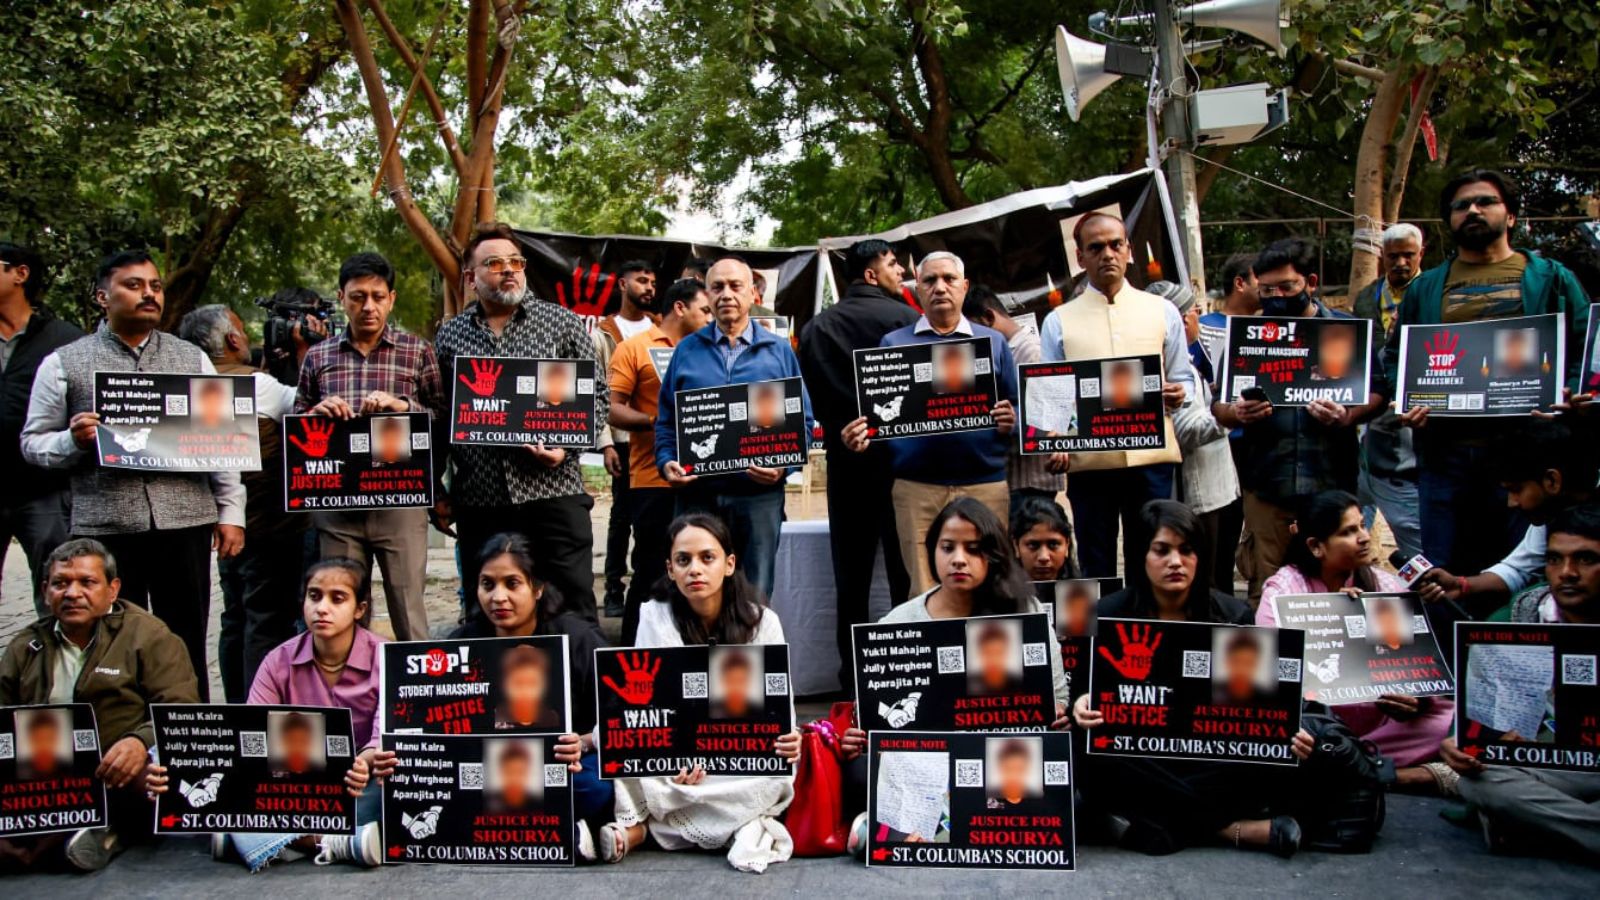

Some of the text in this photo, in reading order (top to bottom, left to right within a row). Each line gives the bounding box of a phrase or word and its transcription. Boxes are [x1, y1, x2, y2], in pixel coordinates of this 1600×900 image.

[1247, 322, 1296, 342] STOP!
[1239, 347, 1309, 356] STUDENT HARASSMENT
[1259, 359, 1304, 373] JUSTICE
[1429, 354, 1455, 366] STOP
[1271, 371, 1293, 382] FOR
[1417, 377, 1464, 385] HARASSMENT
[126, 391, 161, 400] Mahajan
[928, 394, 988, 406] JUSTICE FOR
[1285, 388, 1353, 401] SHOURYA
[473, 399, 511, 412] WANT
[927, 405, 989, 418] SHOURYA
[105, 416, 143, 425] Aparajita
[458, 412, 508, 425] JUSTICE
[1092, 414, 1131, 423] JUSTICE
[524, 420, 587, 430] SHOURYA
[879, 416, 996, 436] ST. COLUMBA'S SCHOOL
[1092, 424, 1157, 435] SHOURYA
[470, 432, 591, 444] ST. COLUMBA'S SCHOOL
[740, 435, 776, 444] JUSTICE
[1039, 436, 1161, 450] ST. COLUMBA'S SCHOOL
[740, 443, 799, 455] SHOURYA
[121, 456, 257, 467] ST. COLUMBA'S SCHOOL
[305, 460, 344, 474] WANT
[695, 453, 804, 472] ST. COLUMBA'S SCHOOL
[360, 470, 400, 478] JUSTICE
[291, 474, 342, 489] JUSTICE
[360, 480, 424, 491] SHOURYA
[305, 494, 429, 507] ST. COLUMBA'S SCHOOL
[868, 632, 894, 640] Manu
[1519, 632, 1550, 641] NOTE
[863, 645, 931, 657] Yukti Mahajan
[407, 646, 470, 674] STOP!
[1368, 656, 1435, 668] JUSTICE FOR
[888, 661, 932, 673] Verghese
[1371, 669, 1441, 681] SHOURYA
[398, 683, 490, 697] STUDENT HARASSMENT
[868, 679, 912, 690] Aparajita
[1320, 680, 1453, 700] ST. COLUMBA'S SCHOOL
[1119, 685, 1174, 704] WANT
[954, 695, 1041, 709] JUSTICE FOR
[168, 712, 194, 720] Manu
[426, 698, 485, 723] JUSTICE
[1100, 705, 1169, 725] JUSTICE
[1193, 706, 1288, 720] JUSTICE FOR
[608, 709, 676, 728] WE WANT
[955, 710, 1043, 726] SHOURYA
[163, 727, 234, 737] Yukti Mahajan
[443, 719, 471, 734] FOR
[697, 724, 781, 734] JUSTICE FOR
[1193, 720, 1287, 737] SHOURYA
[605, 728, 673, 750] JUSTICE
[880, 739, 947, 749] SUICIDE NOTE
[191, 742, 235, 753] Verghese
[396, 742, 419, 752] Manu
[1114, 736, 1292, 758] ST. COLUMBA'S SCHOOL
[1486, 746, 1509, 760] ST.
[170, 758, 215, 769] Aparajita
[415, 759, 453, 769] Mahajan
[624, 759, 643, 773] ST.
[729, 757, 787, 771] SCHOOL
[2, 777, 91, 794] JUSTICE FOR
[413, 775, 453, 785] Verghese
[256, 784, 342, 794] JUSTICE FOR
[2, 791, 93, 810] SHOURYA
[393, 790, 434, 801] Aparajita
[256, 798, 343, 812] SHOURYA
[40, 809, 100, 827] SCHOOL
[182, 814, 351, 830] ST. COLUMBA'S SCHOOL
[473, 816, 559, 826] JUSTICE FOR
[969, 816, 1061, 827] JUSTICE FOR
[473, 830, 560, 842] SHOURYA
[969, 831, 1062, 845] SHOURYA
[406, 845, 568, 860] ST. COLUMBA'S SCHOOL
[893, 847, 1068, 864] ST. COLUMBA'S SCHOOL
